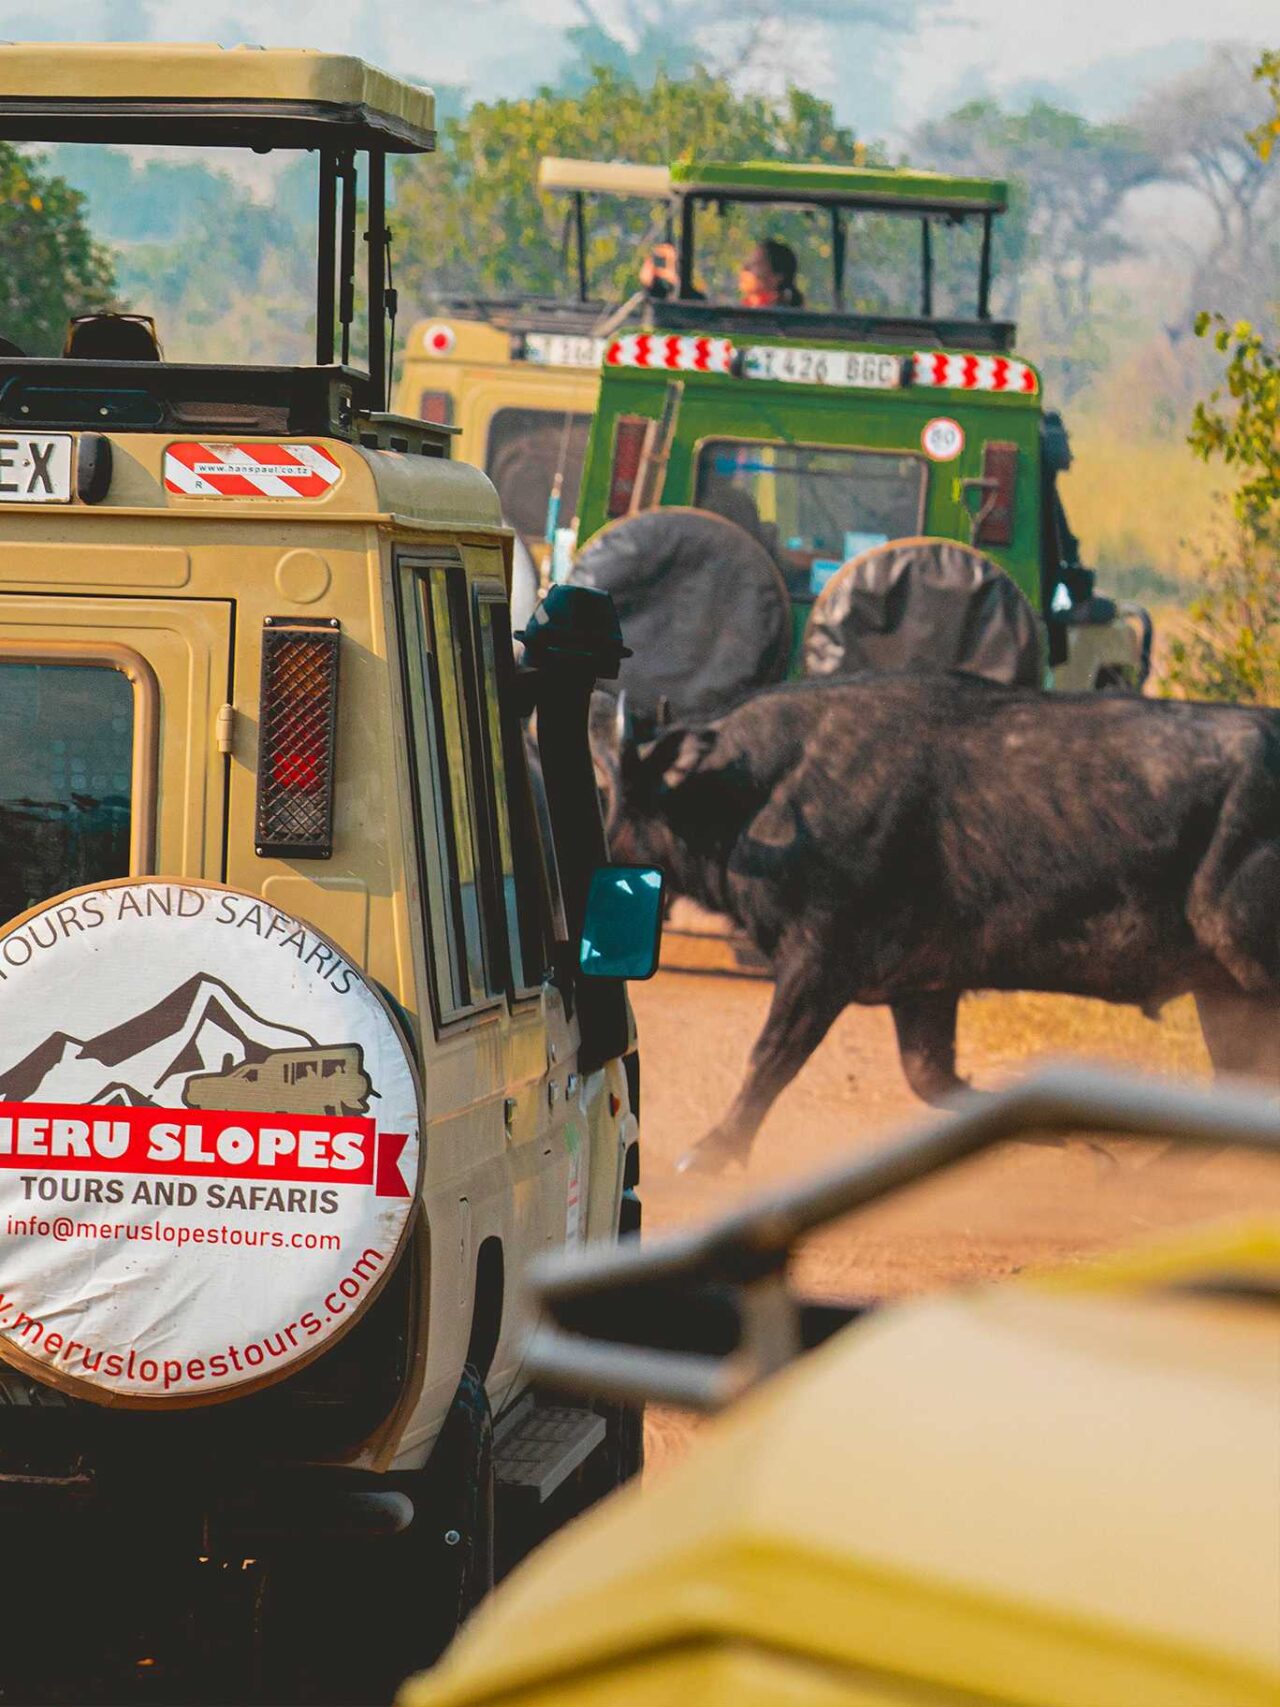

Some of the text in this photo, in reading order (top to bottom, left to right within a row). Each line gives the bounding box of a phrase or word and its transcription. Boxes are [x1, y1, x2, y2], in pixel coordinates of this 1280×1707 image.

[198, 464, 308, 475] www.hanspaul.co.tz
[116, 884, 206, 923] AND
[215, 893, 364, 998] SAFARIS
[146, 1123, 367, 1172] SLOPES
[20, 1175, 341, 1215] TOURS AND SAFARIS
[6, 1214, 342, 1252] info@meruslopestours.com
